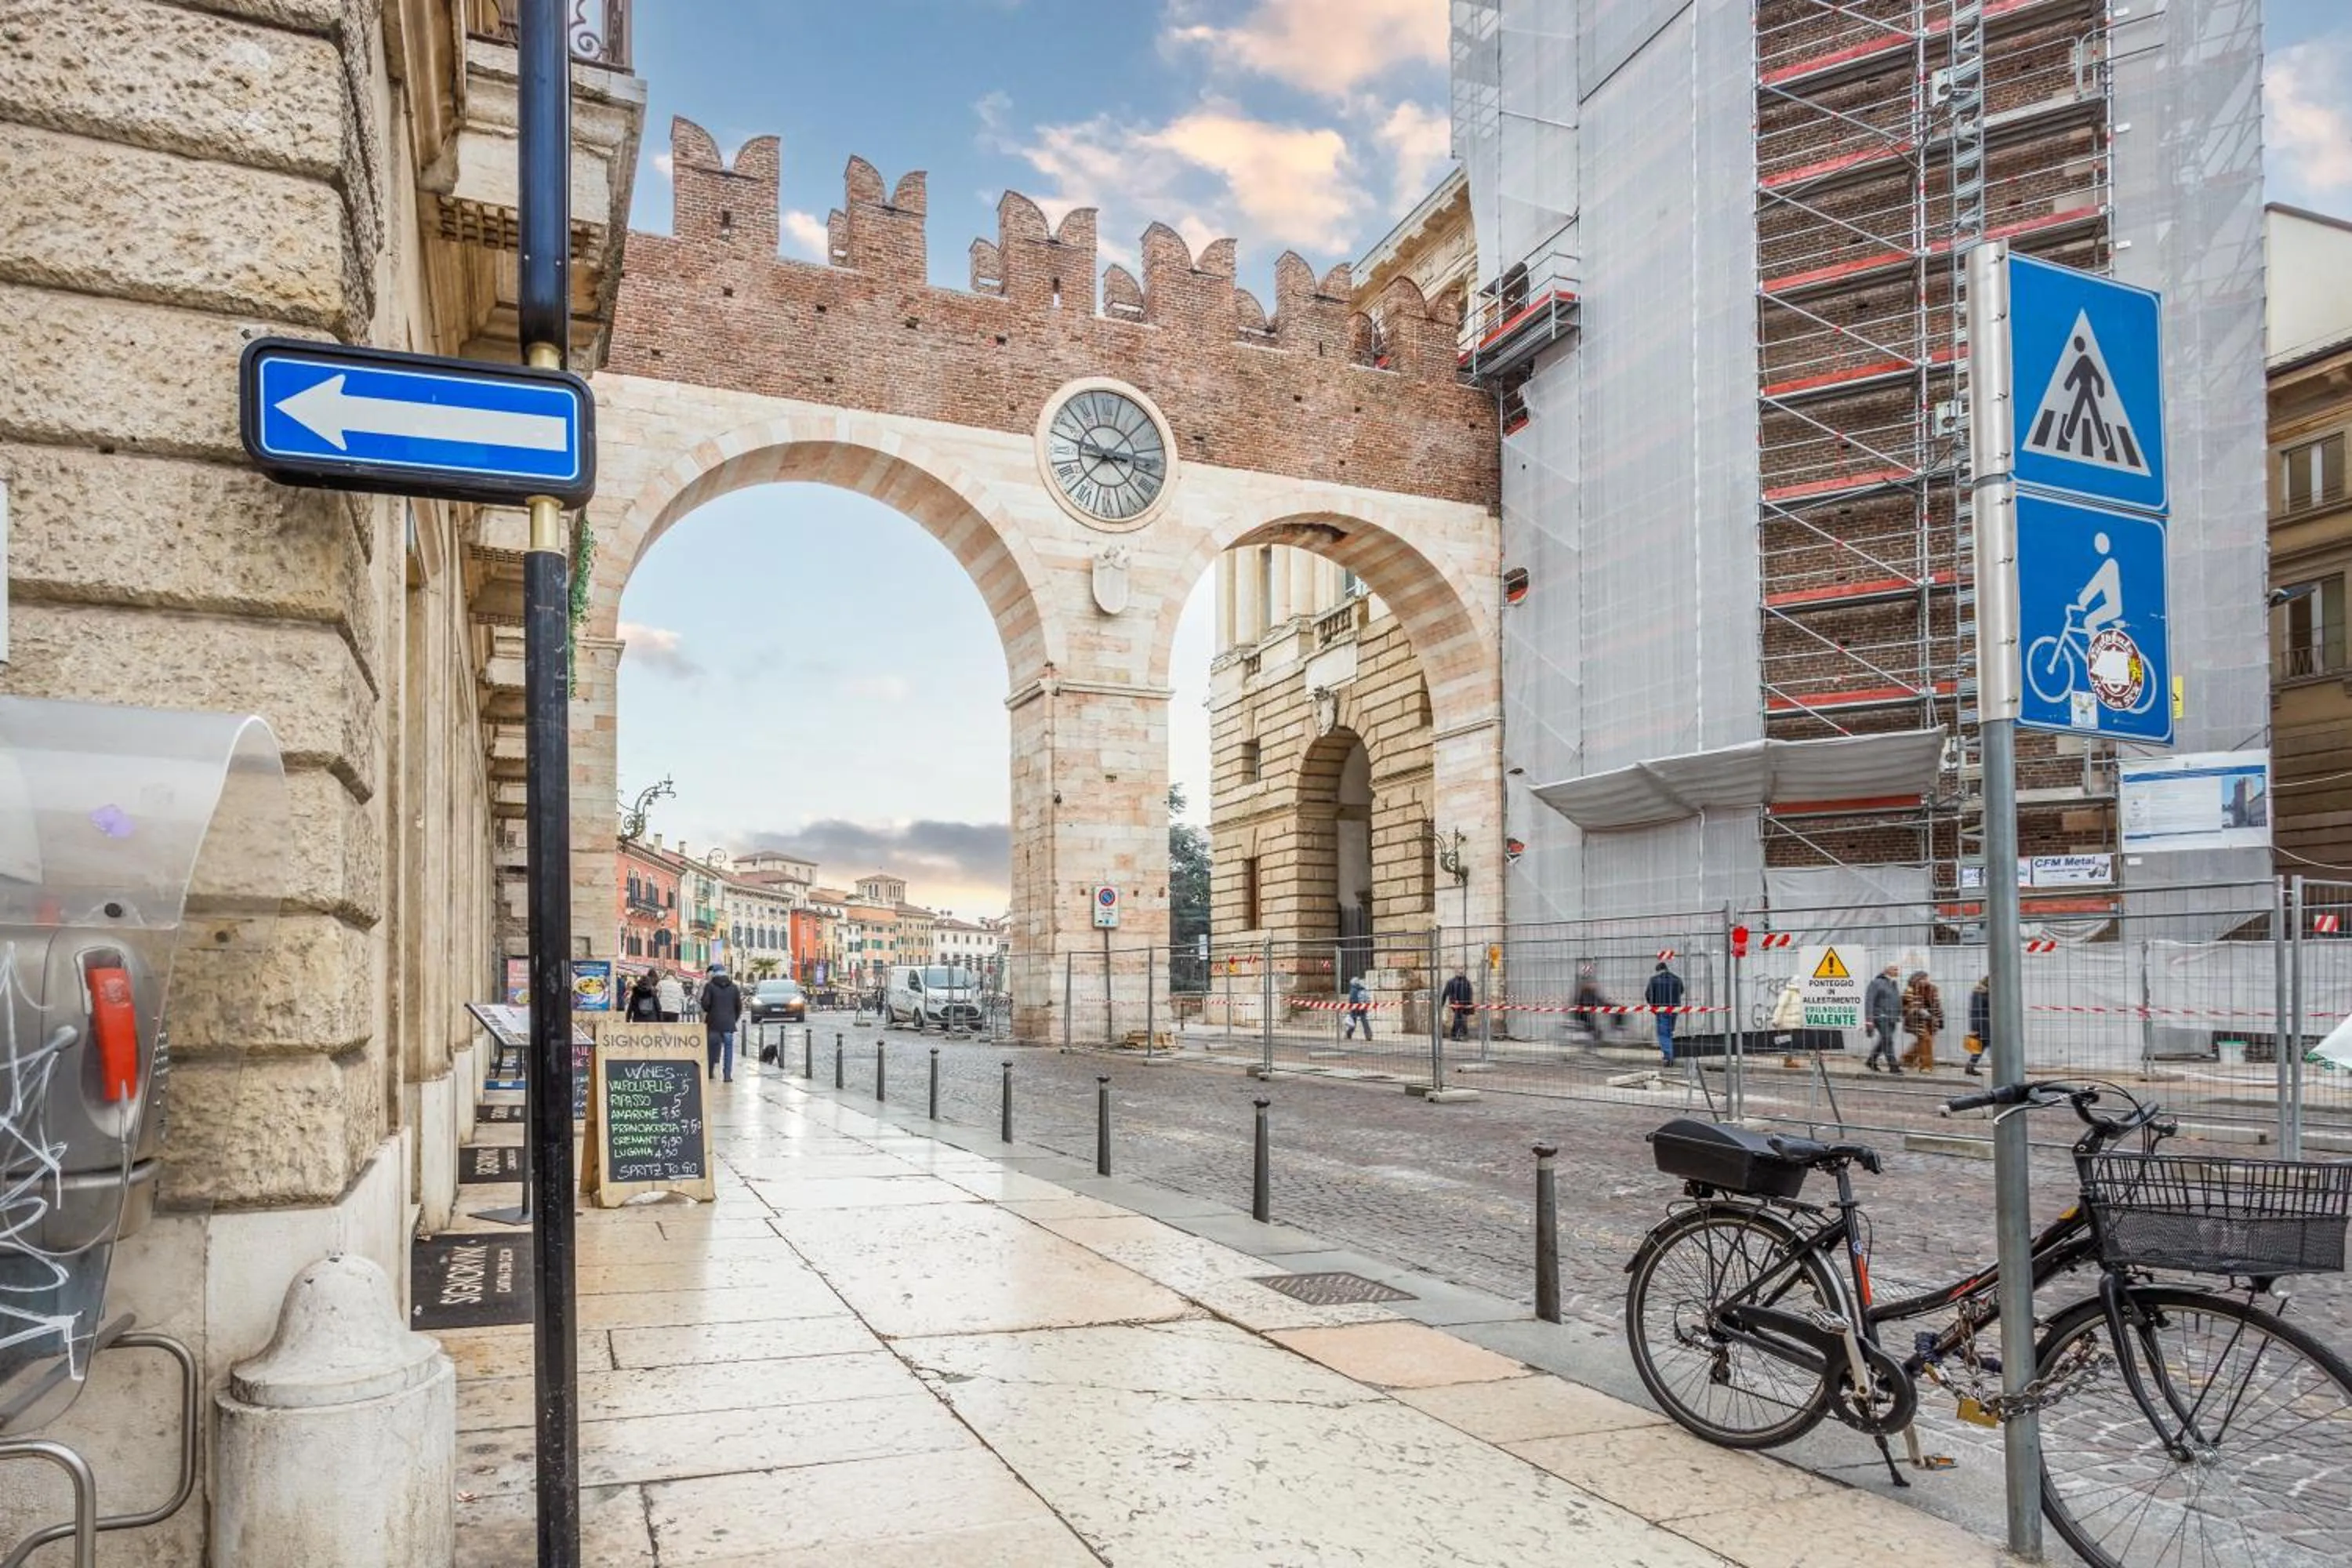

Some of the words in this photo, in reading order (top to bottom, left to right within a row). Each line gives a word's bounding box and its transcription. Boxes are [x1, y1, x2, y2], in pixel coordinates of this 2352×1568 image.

[2035, 858, 2061, 868] CFM
[2064, 856, 2096, 866] Metal
[1806, 1014, 1857, 1025] VALENTE
[602, 1034, 701, 1047] SIGNORVINO
[610, 1094, 652, 1108] RIPASSO
[611, 1108, 660, 1120] AMARONE
[612, 1136, 660, 1145] CREMANT
[614, 1147, 653, 1158] LUGANA
[617, 1163, 664, 1180] SPRITZ
[665, 1163, 679, 1174] TO
[681, 1161, 698, 1174] GO
